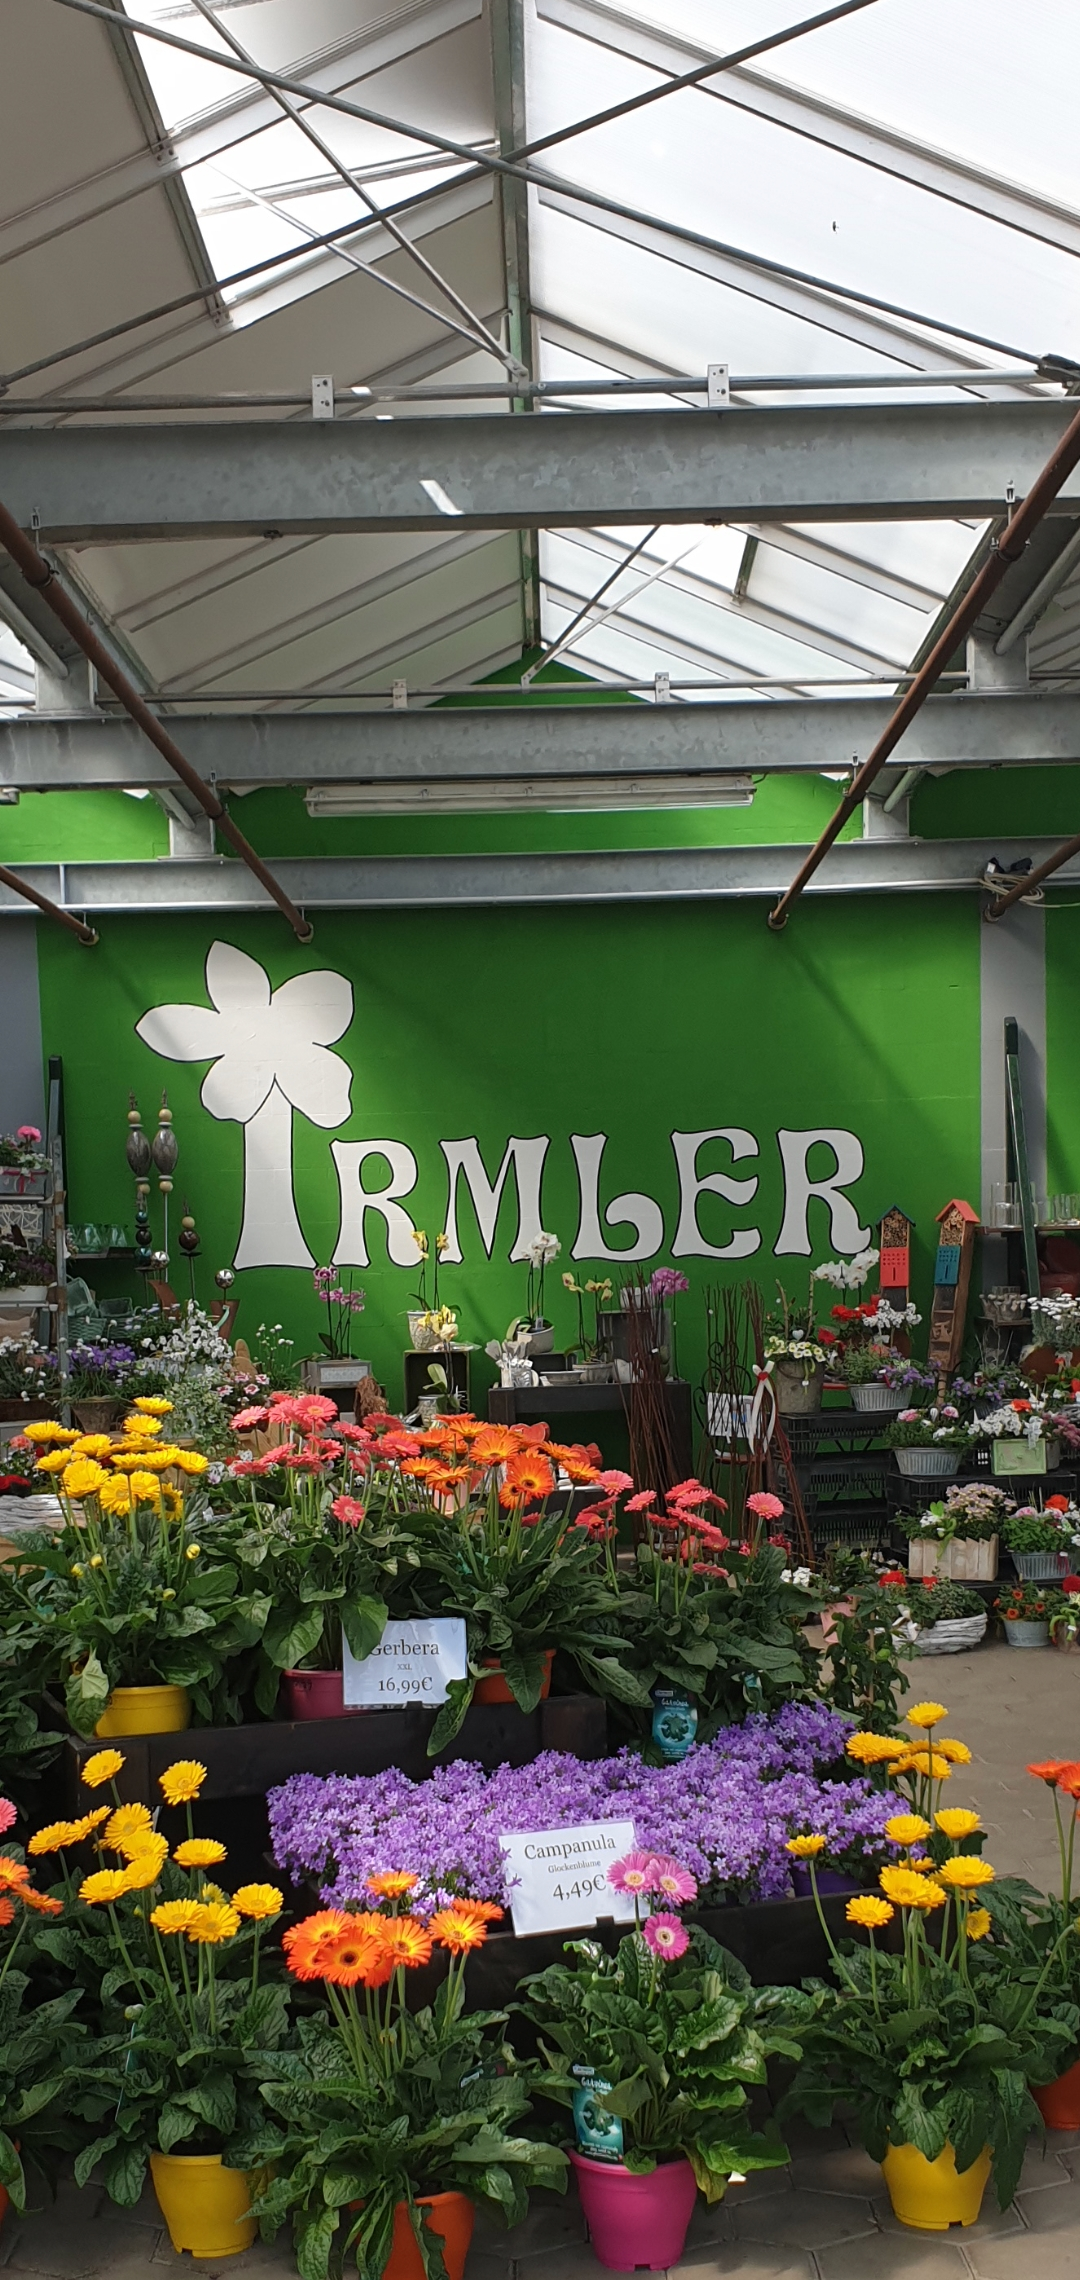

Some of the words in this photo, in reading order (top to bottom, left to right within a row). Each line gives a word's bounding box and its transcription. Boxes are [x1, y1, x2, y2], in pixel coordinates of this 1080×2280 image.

[233, 1073, 872, 1270] IRMLER
[397, 1663, 412, 1671] XXL
[378, 1677, 433, 1695] 16,99€
[524, 1834, 616, 1860] Campanula
[548, 1860, 601, 1873] Glockenblume
[552, 1874, 607, 1901] 4,49€
